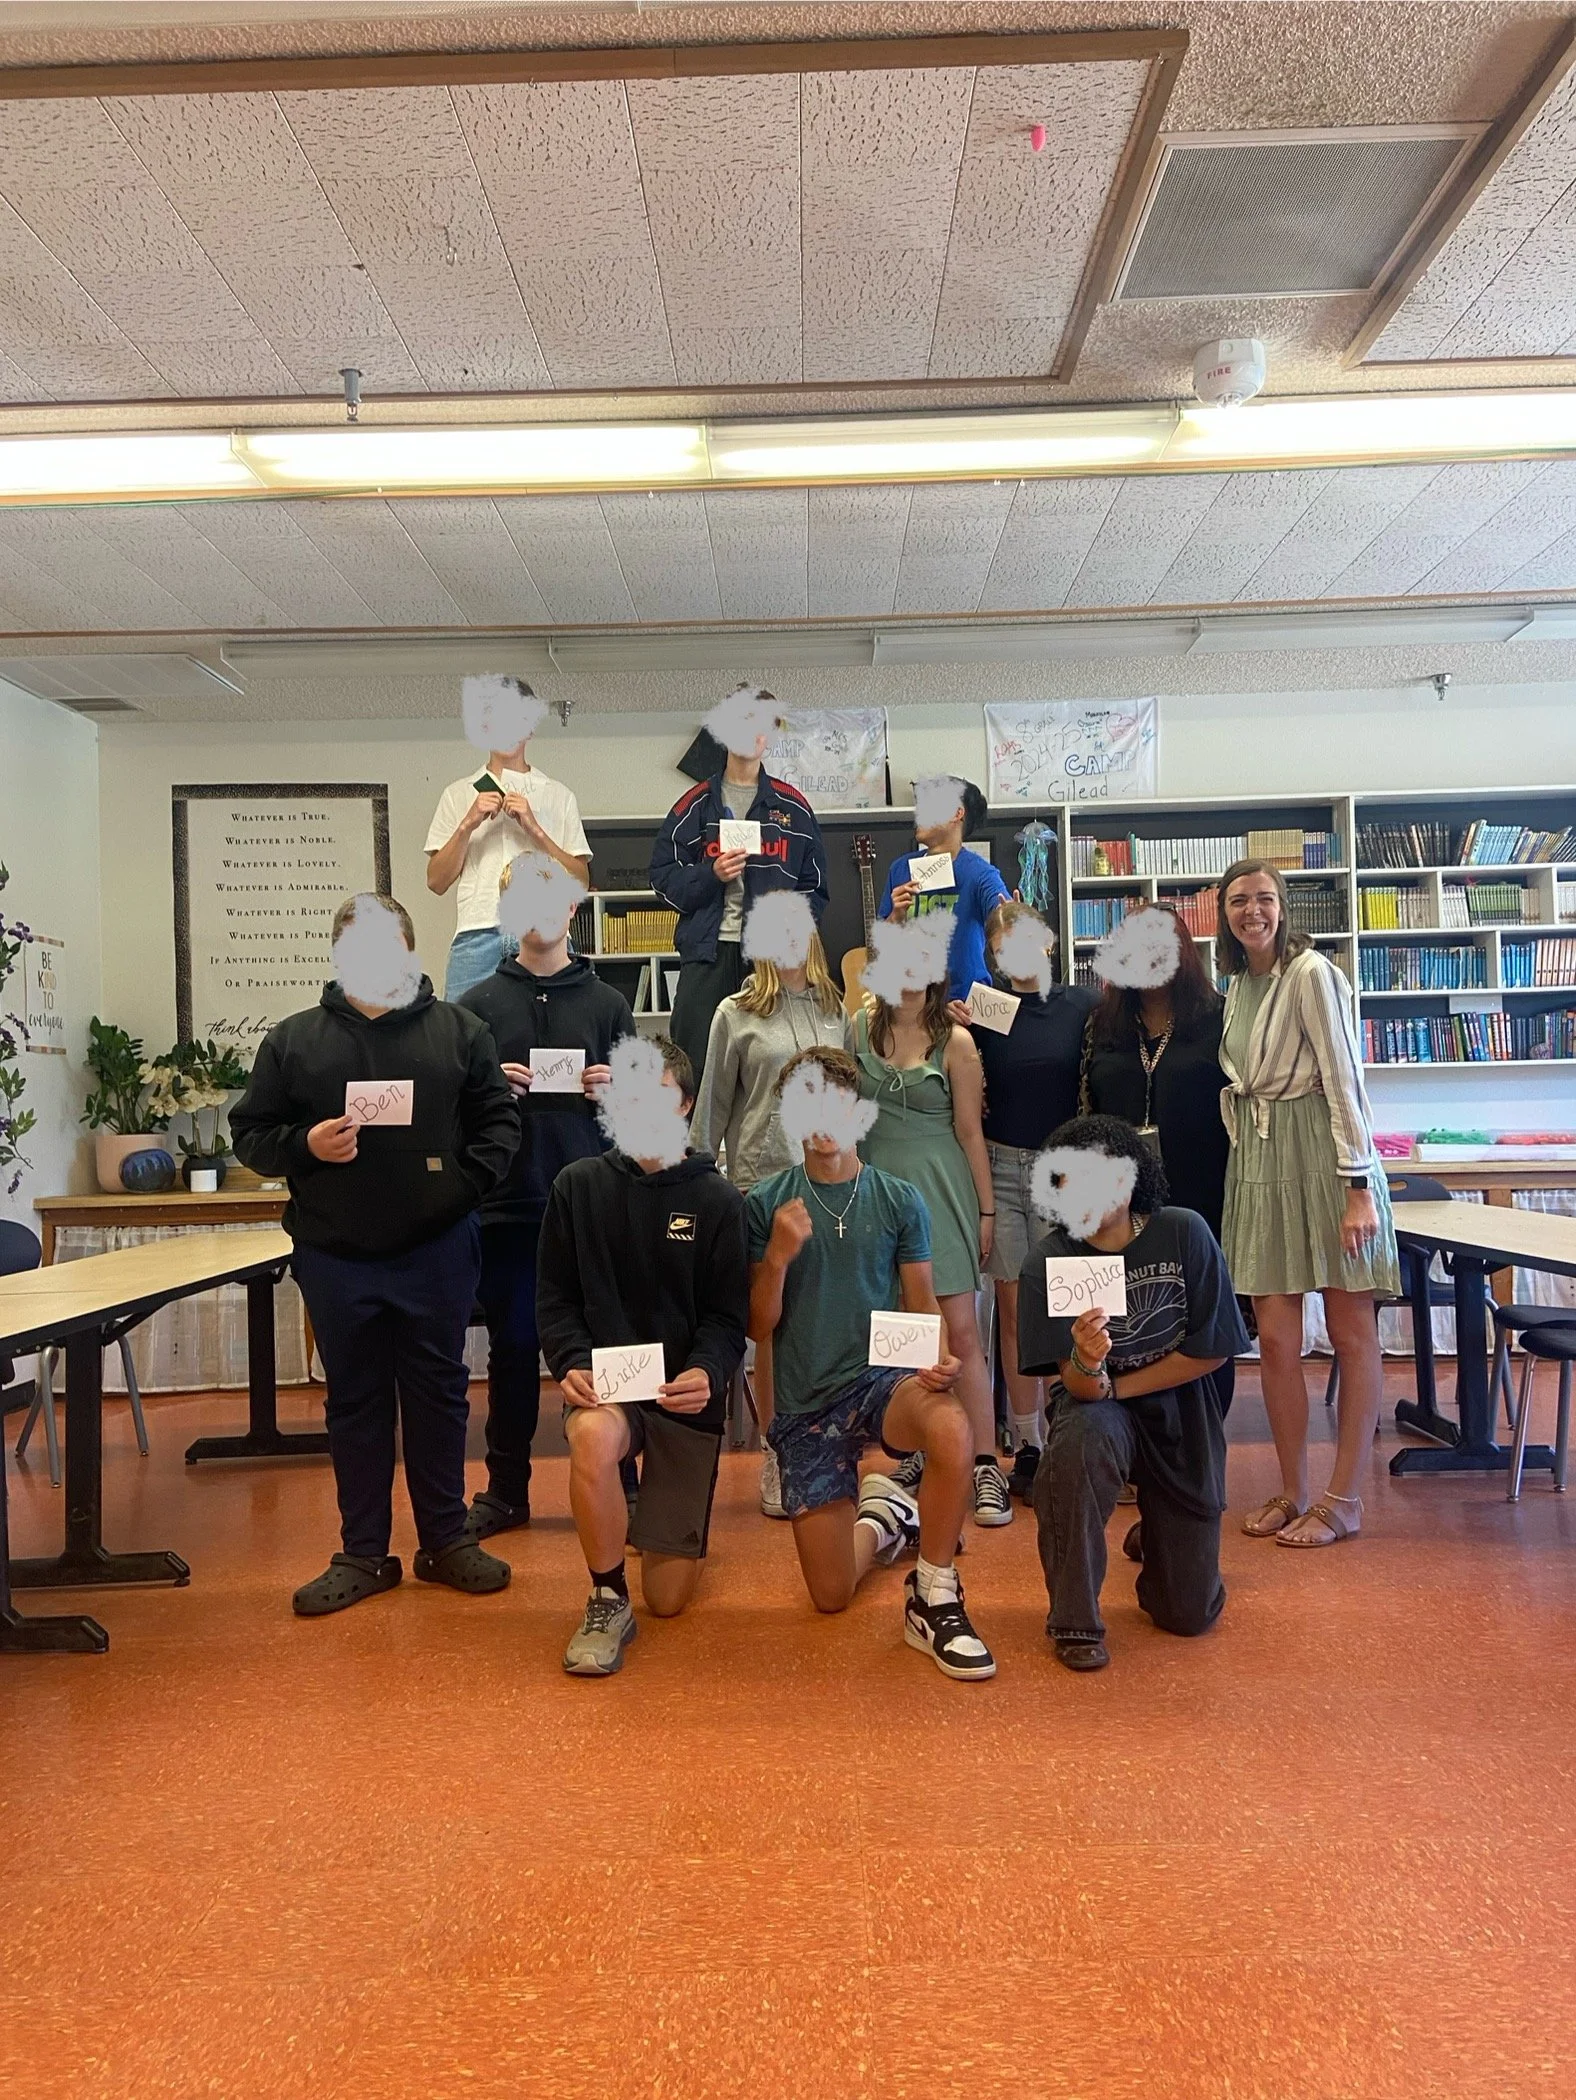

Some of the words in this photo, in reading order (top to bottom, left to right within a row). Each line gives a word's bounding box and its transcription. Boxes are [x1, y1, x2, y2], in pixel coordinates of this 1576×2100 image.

[1207, 366, 1231, 379] FIRE
[1064, 751, 1137, 777] CAMP
[1047, 774, 1108, 803] Gilead
[41, 951, 53, 971] BE
[43, 991, 54, 1010] TO
[970, 992, 1011, 1018] Nora
[28, 1012, 64, 1036] everyone
[204, 1017, 250, 1039] think
[535, 1055, 574, 1082] Henry
[349, 1084, 406, 1123] Ben
[1126, 1264, 1157, 1283] NUT
[1159, 1261, 1183, 1276] BAY
[1048, 1259, 1124, 1312] Sophia
[874, 1325, 935, 1359] Owen
[597, 1351, 652, 1400] Luke
